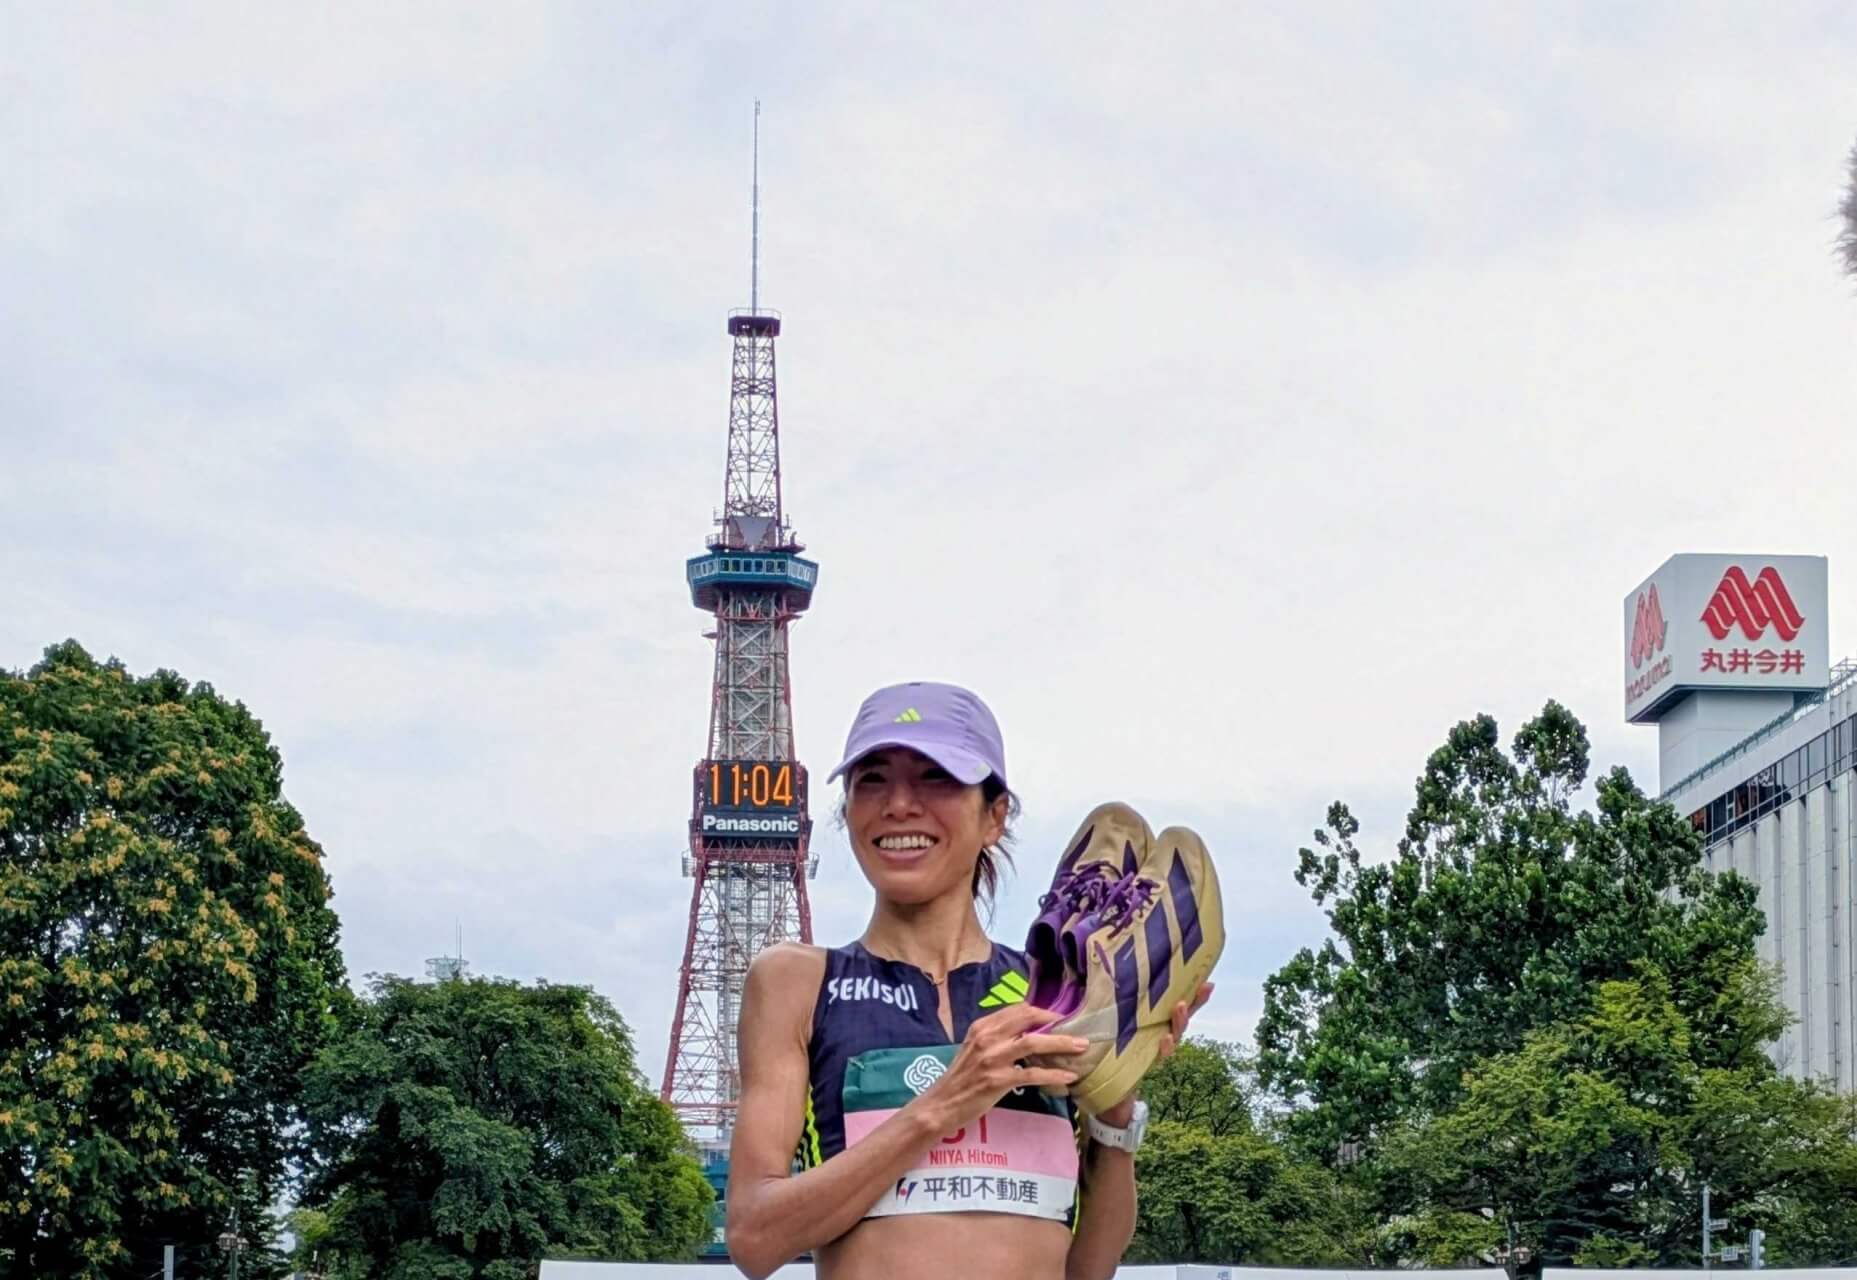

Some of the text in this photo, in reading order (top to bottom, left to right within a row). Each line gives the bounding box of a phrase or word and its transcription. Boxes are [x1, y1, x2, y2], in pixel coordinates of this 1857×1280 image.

[1701, 648, 1805, 674] 丸井今井
[711, 764, 792, 806] 11:04
[703, 815, 799, 832] Panasonic
[827, 976, 918, 1012] SEKISUI
[930, 1150, 1008, 1167] NIIYA Hitomi
[923, 1176, 1039, 1204] 平和不動産
